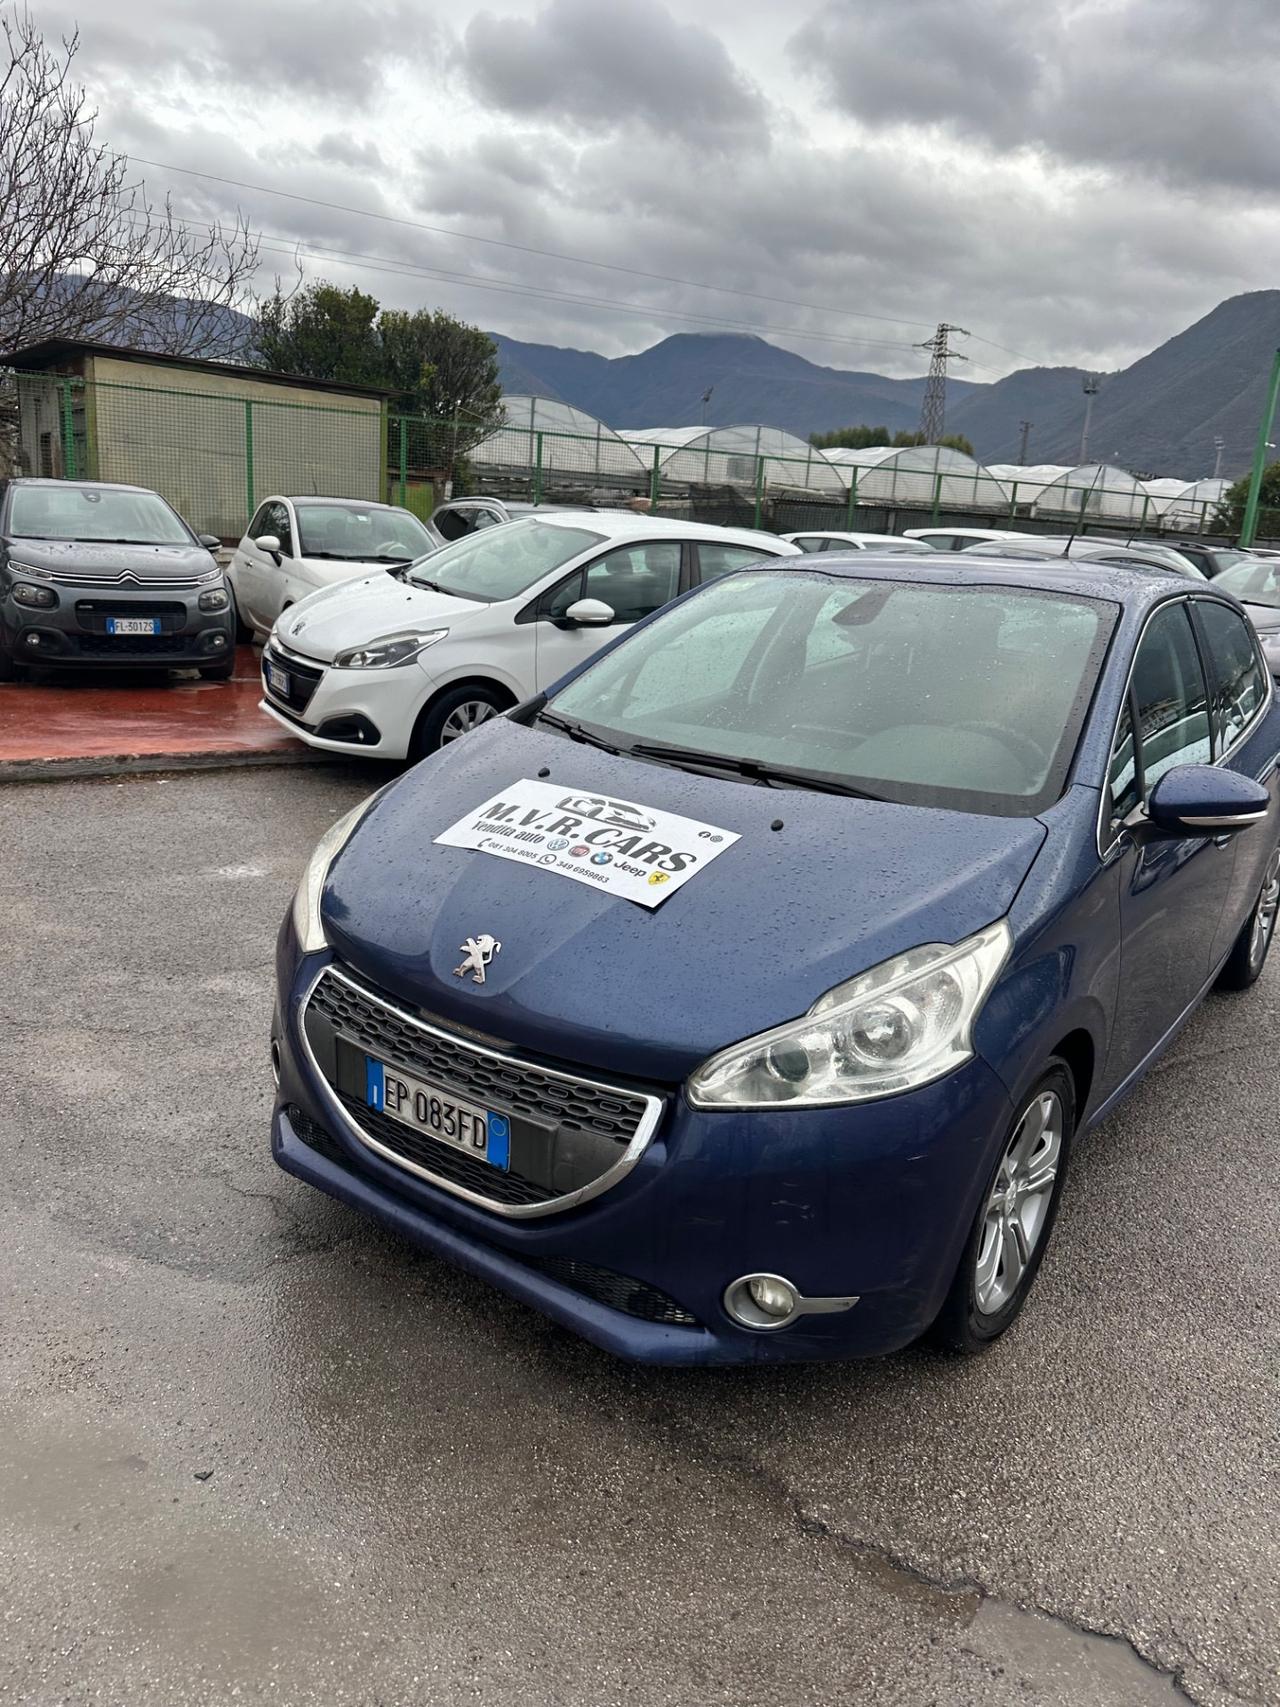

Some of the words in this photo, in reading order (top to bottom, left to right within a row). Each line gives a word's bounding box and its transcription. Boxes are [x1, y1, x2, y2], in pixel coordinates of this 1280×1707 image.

[472, 820, 516, 837] Vendita
[514, 830, 546, 844] auto
[584, 828, 697, 872] CARS
[556, 860, 574, 870] 349
[614, 861, 647, 878] Jeep
[385, 1076, 408, 1111] EP
[416, 1091, 487, 1149] 083FD
